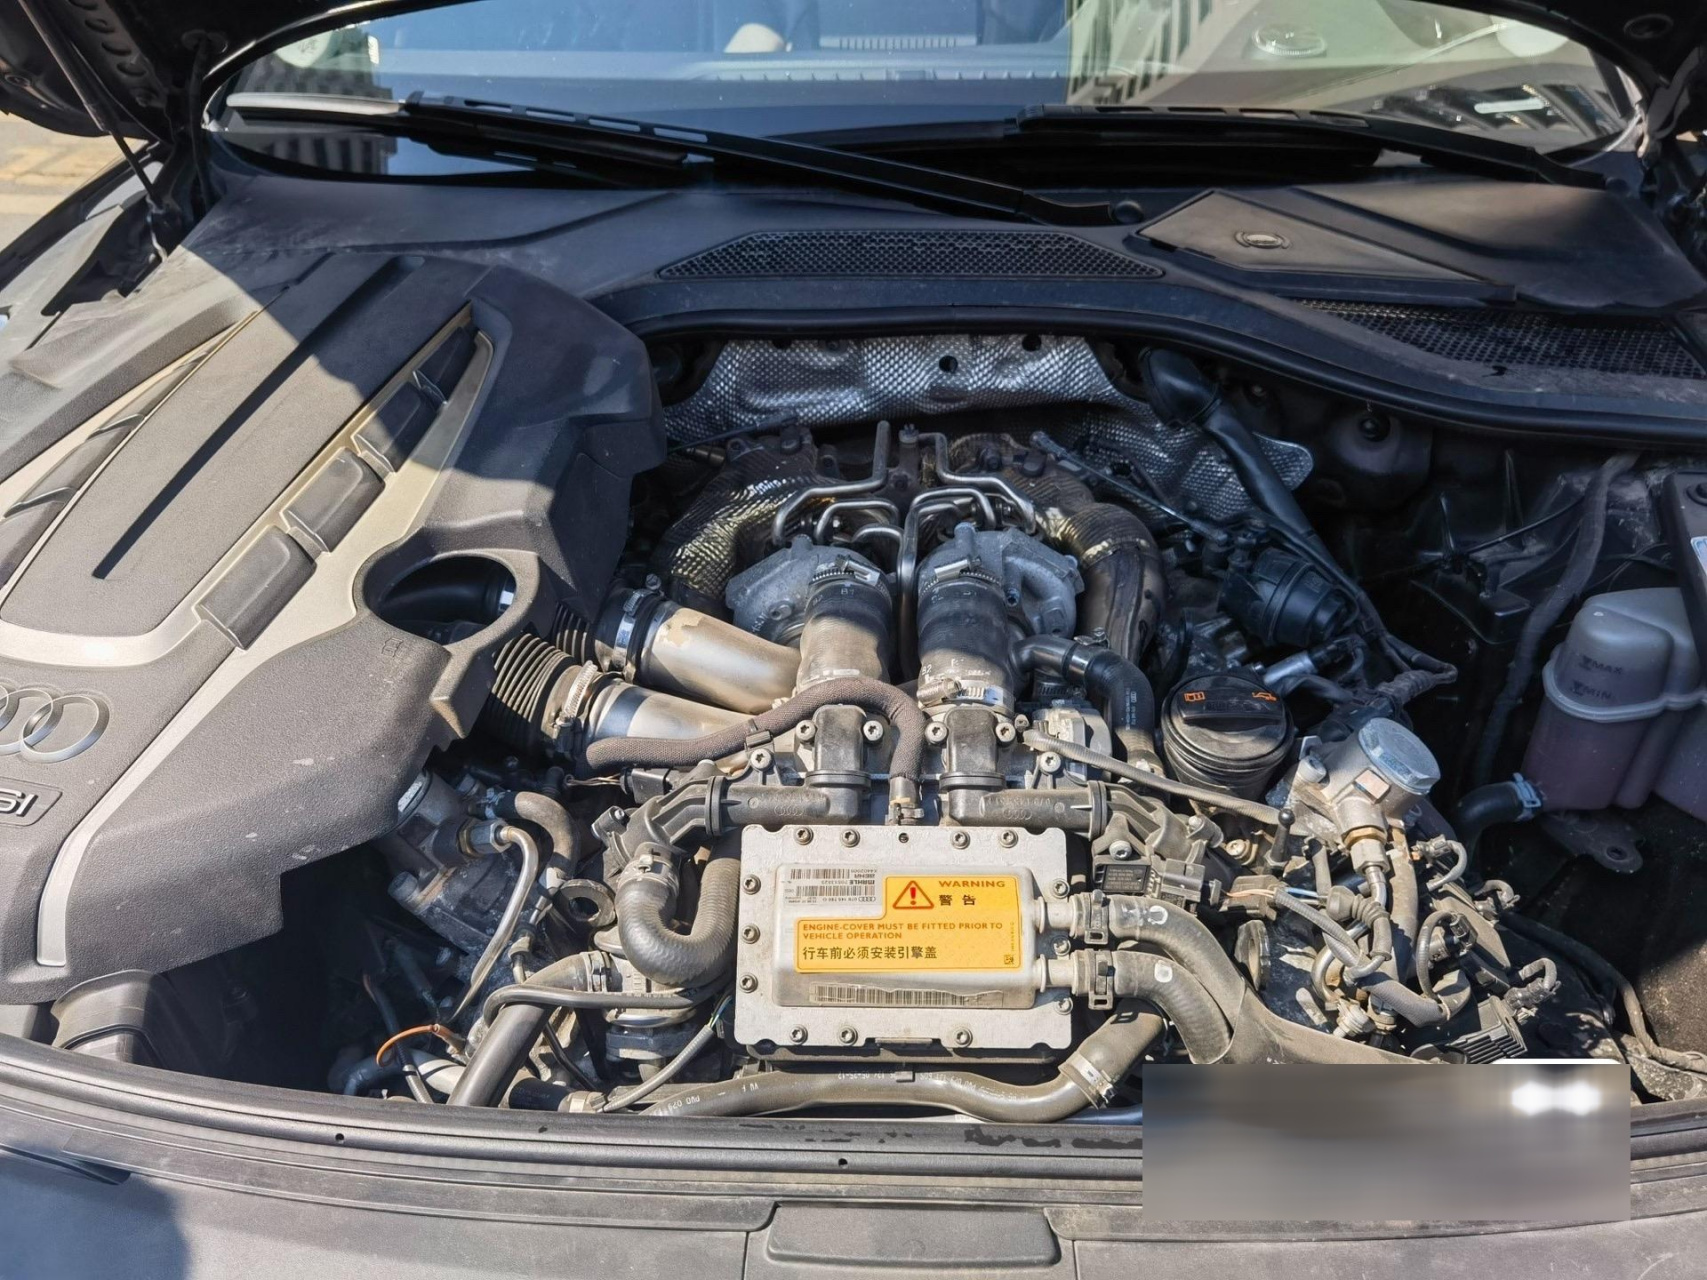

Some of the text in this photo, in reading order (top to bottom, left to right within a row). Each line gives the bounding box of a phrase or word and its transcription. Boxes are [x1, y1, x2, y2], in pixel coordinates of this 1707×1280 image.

[938, 880, 1006, 888] WARNING
[938, 894, 976, 906] 警告
[802, 922, 1003, 931] ENGINE-COVER MUST BE FITTED PRIOR TO
[802, 932, 903, 940] VEHICLE OPERATION
[802, 946, 938, 960] 行车前必须安装引擎盖
